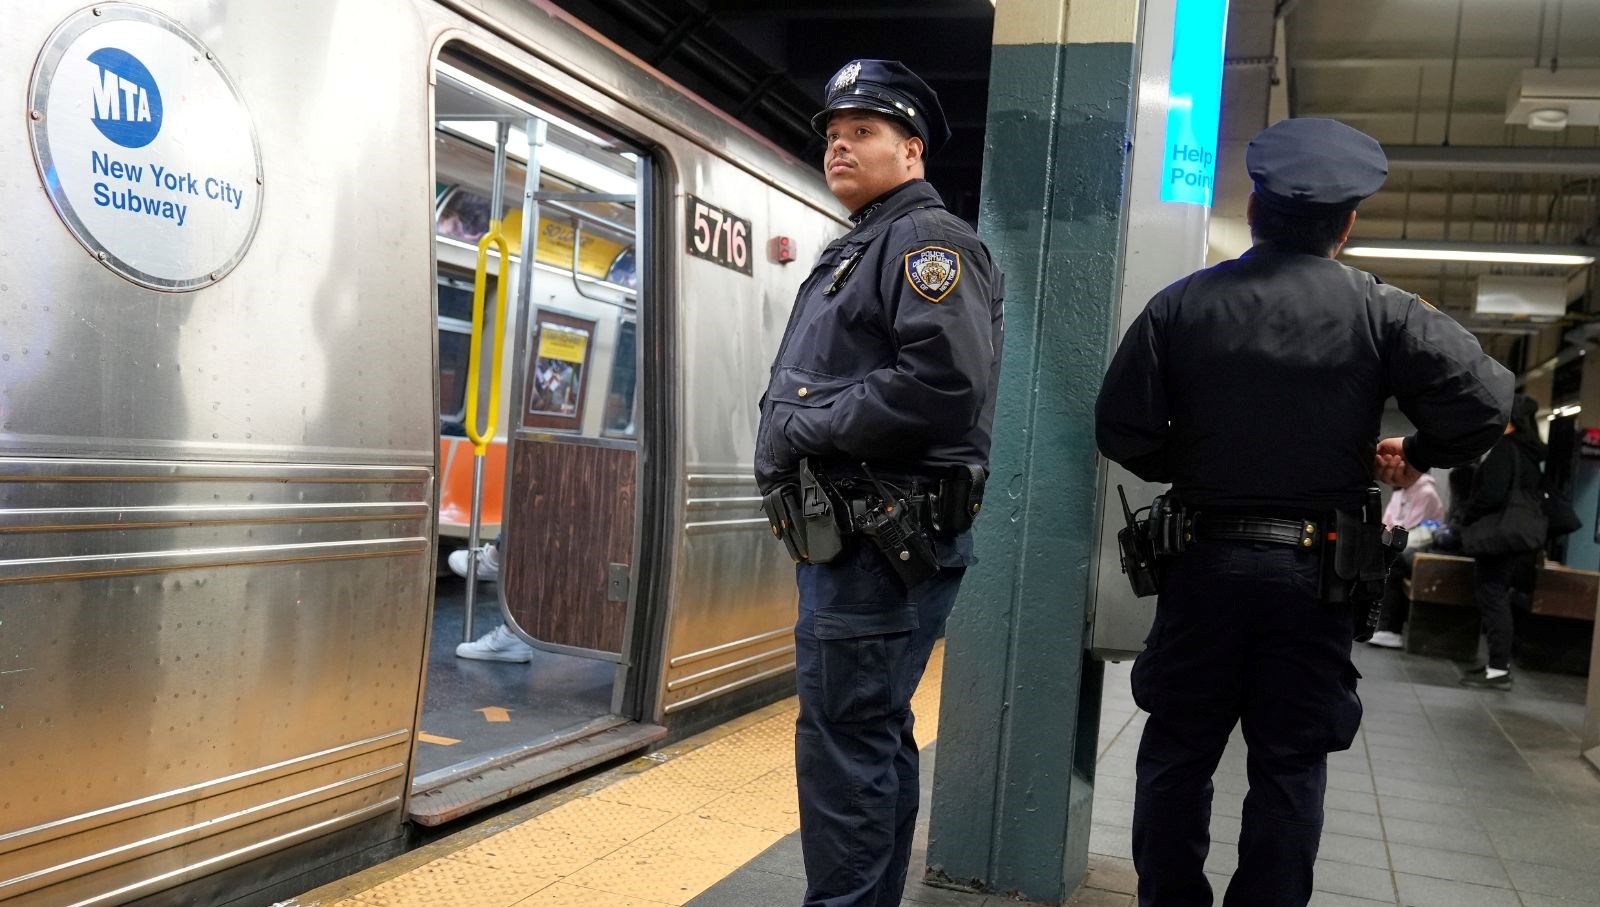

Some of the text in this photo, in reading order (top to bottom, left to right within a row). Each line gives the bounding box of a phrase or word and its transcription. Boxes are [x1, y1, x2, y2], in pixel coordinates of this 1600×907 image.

[88, 63, 152, 122] MTA
[92, 150, 243, 210] New York City
[1173, 144, 1212, 168] Help
[93, 182, 187, 226] Subway
[694, 202, 747, 267] 5716
[912, 272, 921, 283] CITY
